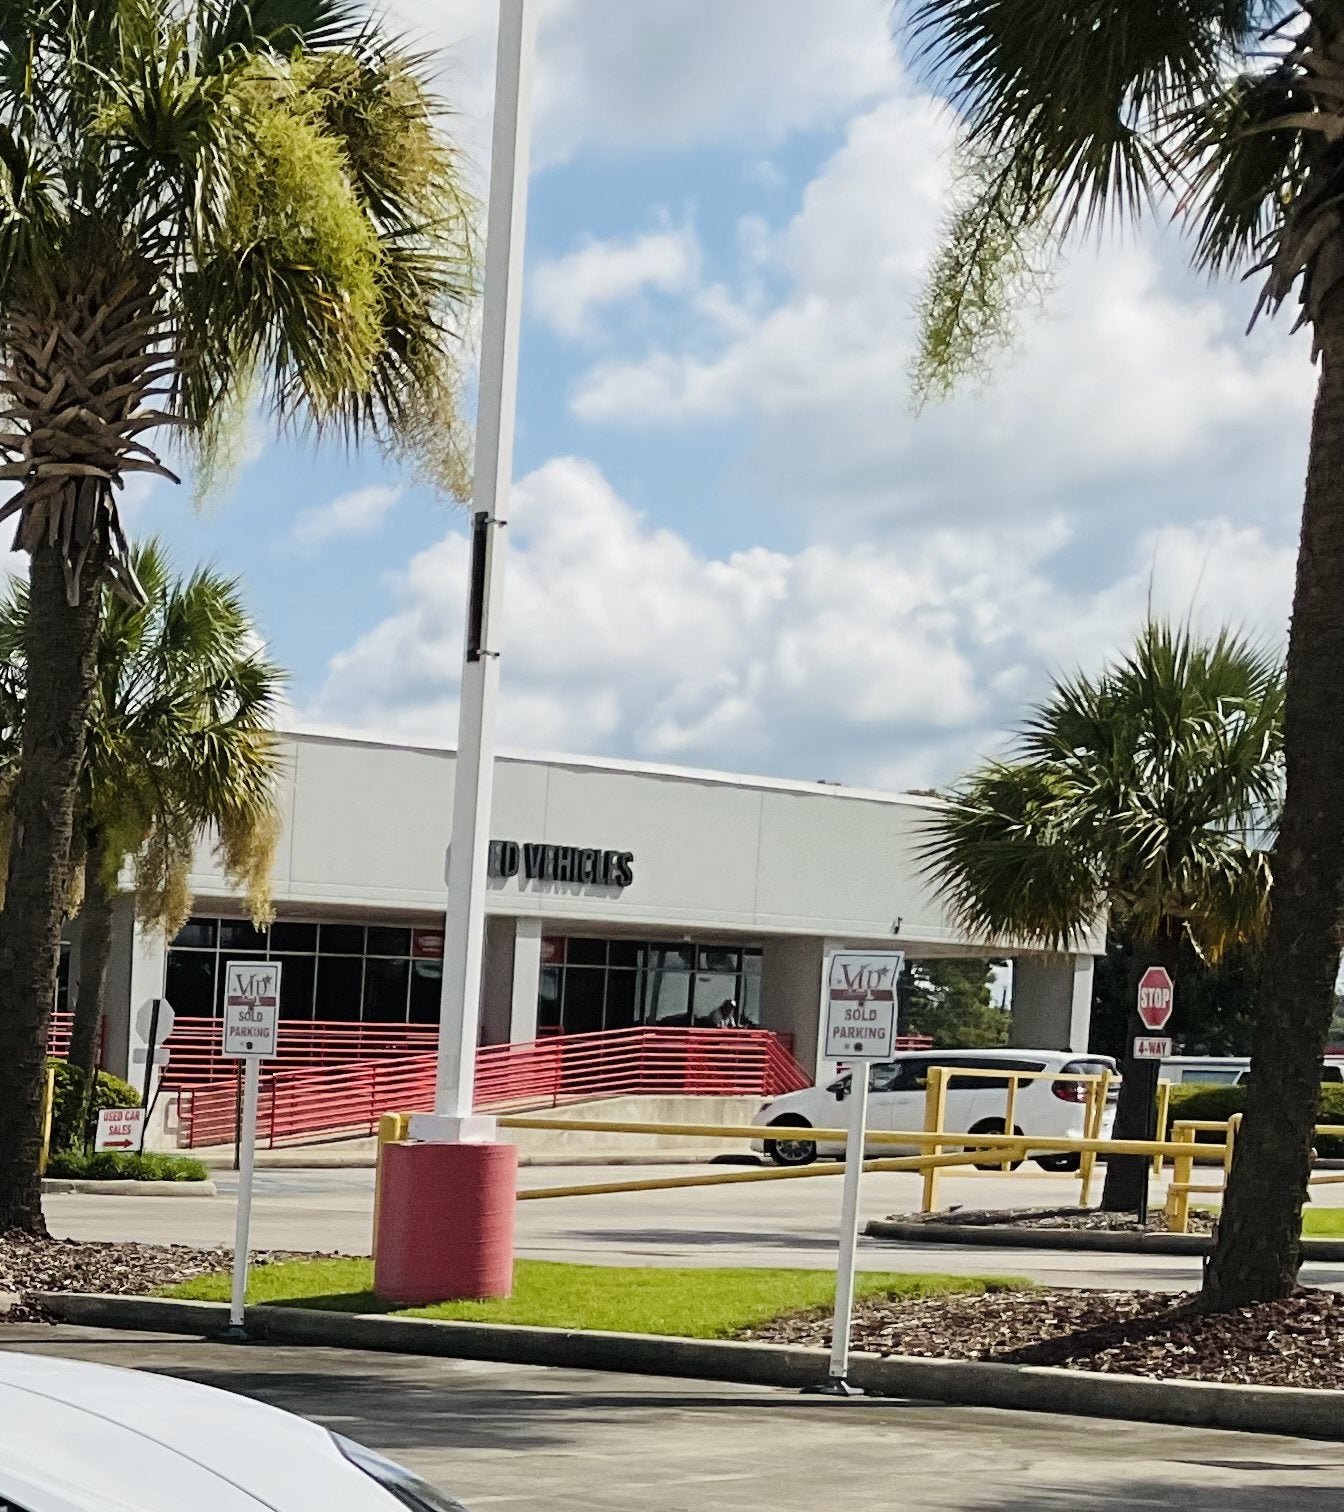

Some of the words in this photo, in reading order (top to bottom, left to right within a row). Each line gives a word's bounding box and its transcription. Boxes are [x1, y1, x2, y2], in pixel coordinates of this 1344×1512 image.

[488, 840, 520, 877] ED
[523, 843, 634, 887] VEHICLES
[1141, 987, 1170, 1008] STOP
[238, 1011, 263, 1022] SOLD
[844, 1008, 877, 1021] SOLD
[229, 1026, 270, 1037] PARKING
[832, 1026, 886, 1039] PARKING
[1138, 1041, 1167, 1055] 4-WAY
[103, 1111, 122, 1121] USED
[125, 1110, 140, 1120] CAR
[109, 1125, 132, 1136] SALES
